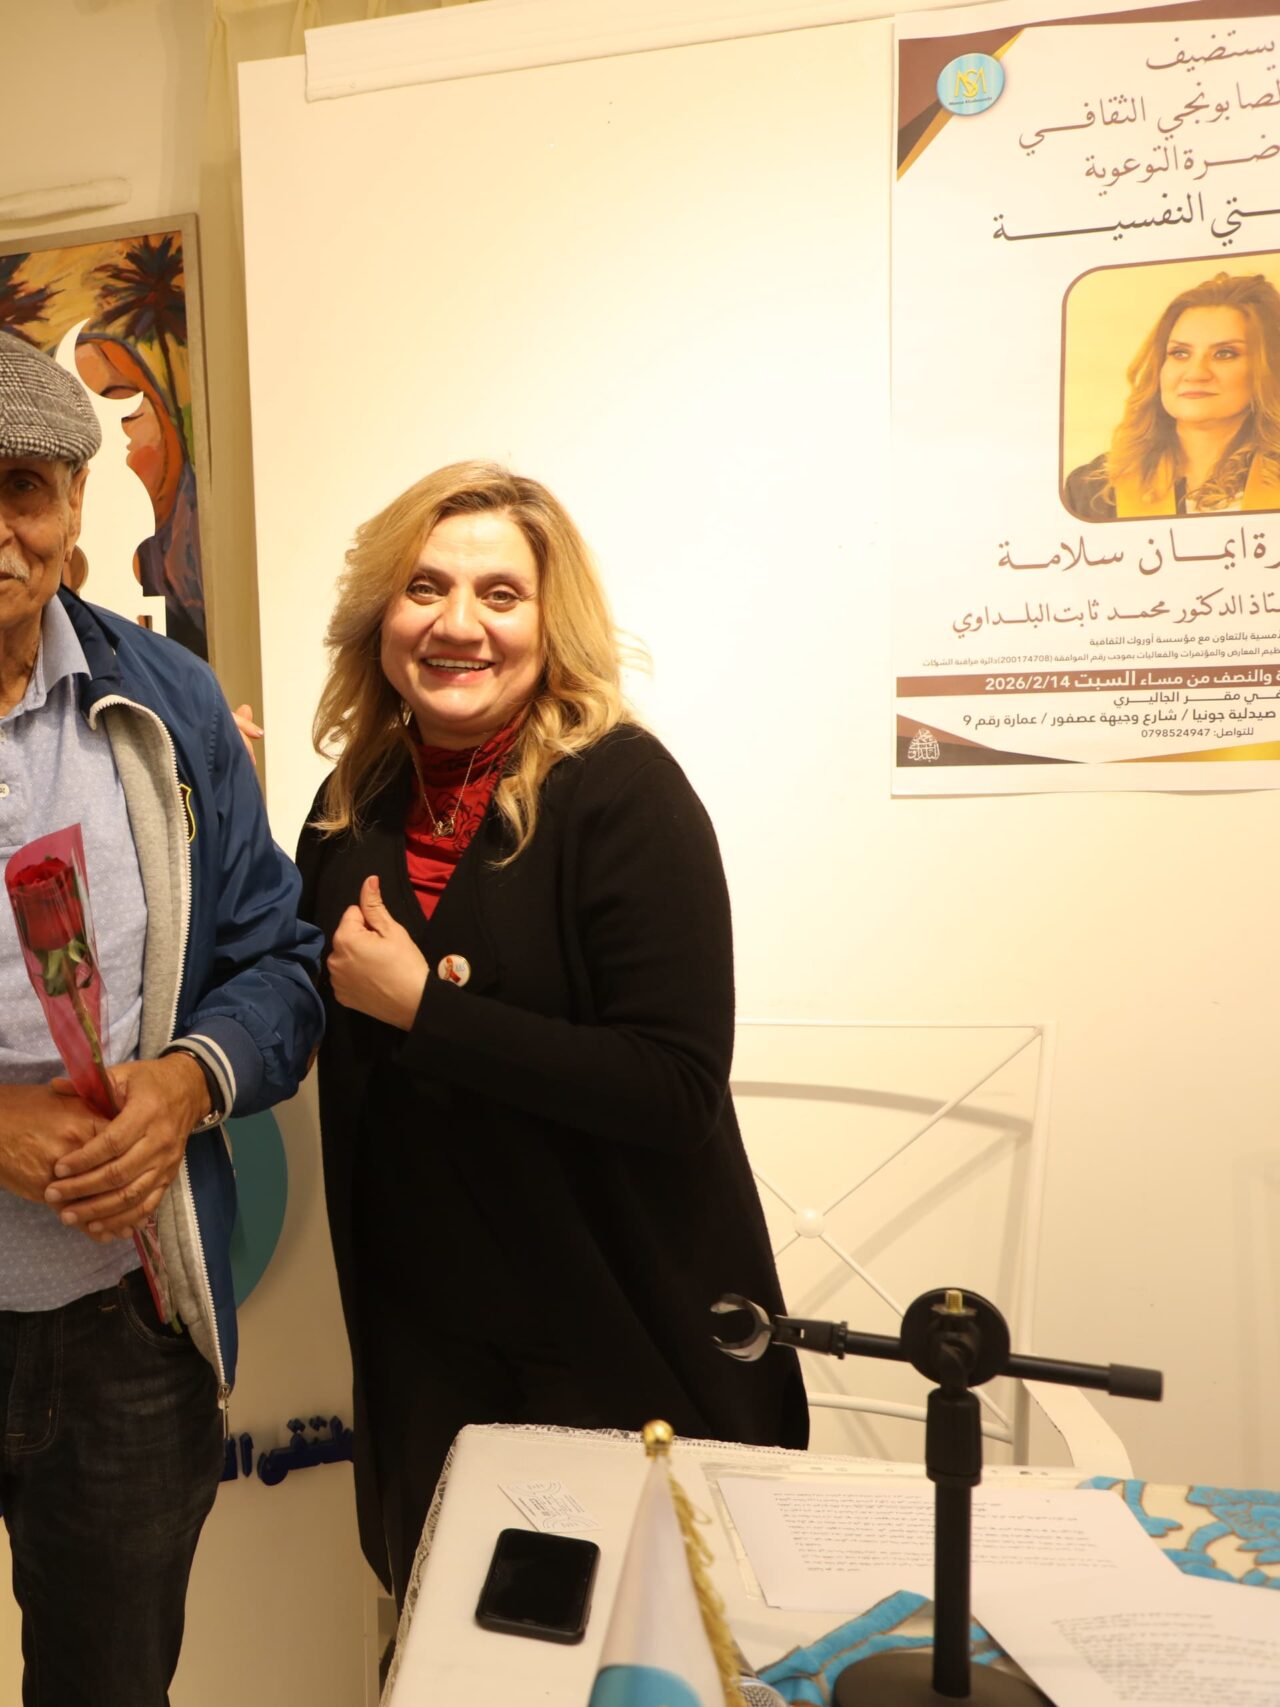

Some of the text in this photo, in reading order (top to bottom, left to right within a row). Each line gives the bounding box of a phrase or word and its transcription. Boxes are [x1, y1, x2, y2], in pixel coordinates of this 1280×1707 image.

[1146, 29, 1276, 73] يستضيف
[1019, 78, 1280, 157] لصابونجي الثقافي
[1084, 145, 1179, 197] التوعوية
[992, 192, 1205, 242] النفسية
[997, 535, 1124, 571] سلامة
[1053, 599, 1100, 627] ثابت
[1107, 600, 1170, 621] محمد
[1173, 587, 1243, 624] الدكتور
[952, 601, 1050, 639] البلداوي
[1089, 636, 1125, 647] الثقافية
[1127, 633, 1154, 646] أوروك
[1156, 634, 1196, 644] مؤسسة
[1197, 635, 1210, 645] مع
[1212, 632, 1248, 643] بالتعاون
[985, 675, 1071, 691] 2026/2/14
[1074, 670, 1136, 690] السبت
[1140, 673, 1184, 686] مساء
[1186, 671, 1210, 688] من
[1213, 668, 1272, 685] والنصف
[1113, 692, 1179, 707] الجاليري
[1183, 691, 1240, 704] مقر
[962, 715, 971, 726] 9
[1003, 714, 1037, 727] عمارة
[1050, 713, 1096, 728] عصفور
[1099, 711, 1139, 727] وجيهة
[1142, 709, 1177, 726] شارع
[1192, 708, 1225, 723] جونيا
[1228, 707, 1277, 721] صيدلية
[974, 716, 1000, 730] رقم
[1141, 728, 1211, 738] 0798524947
